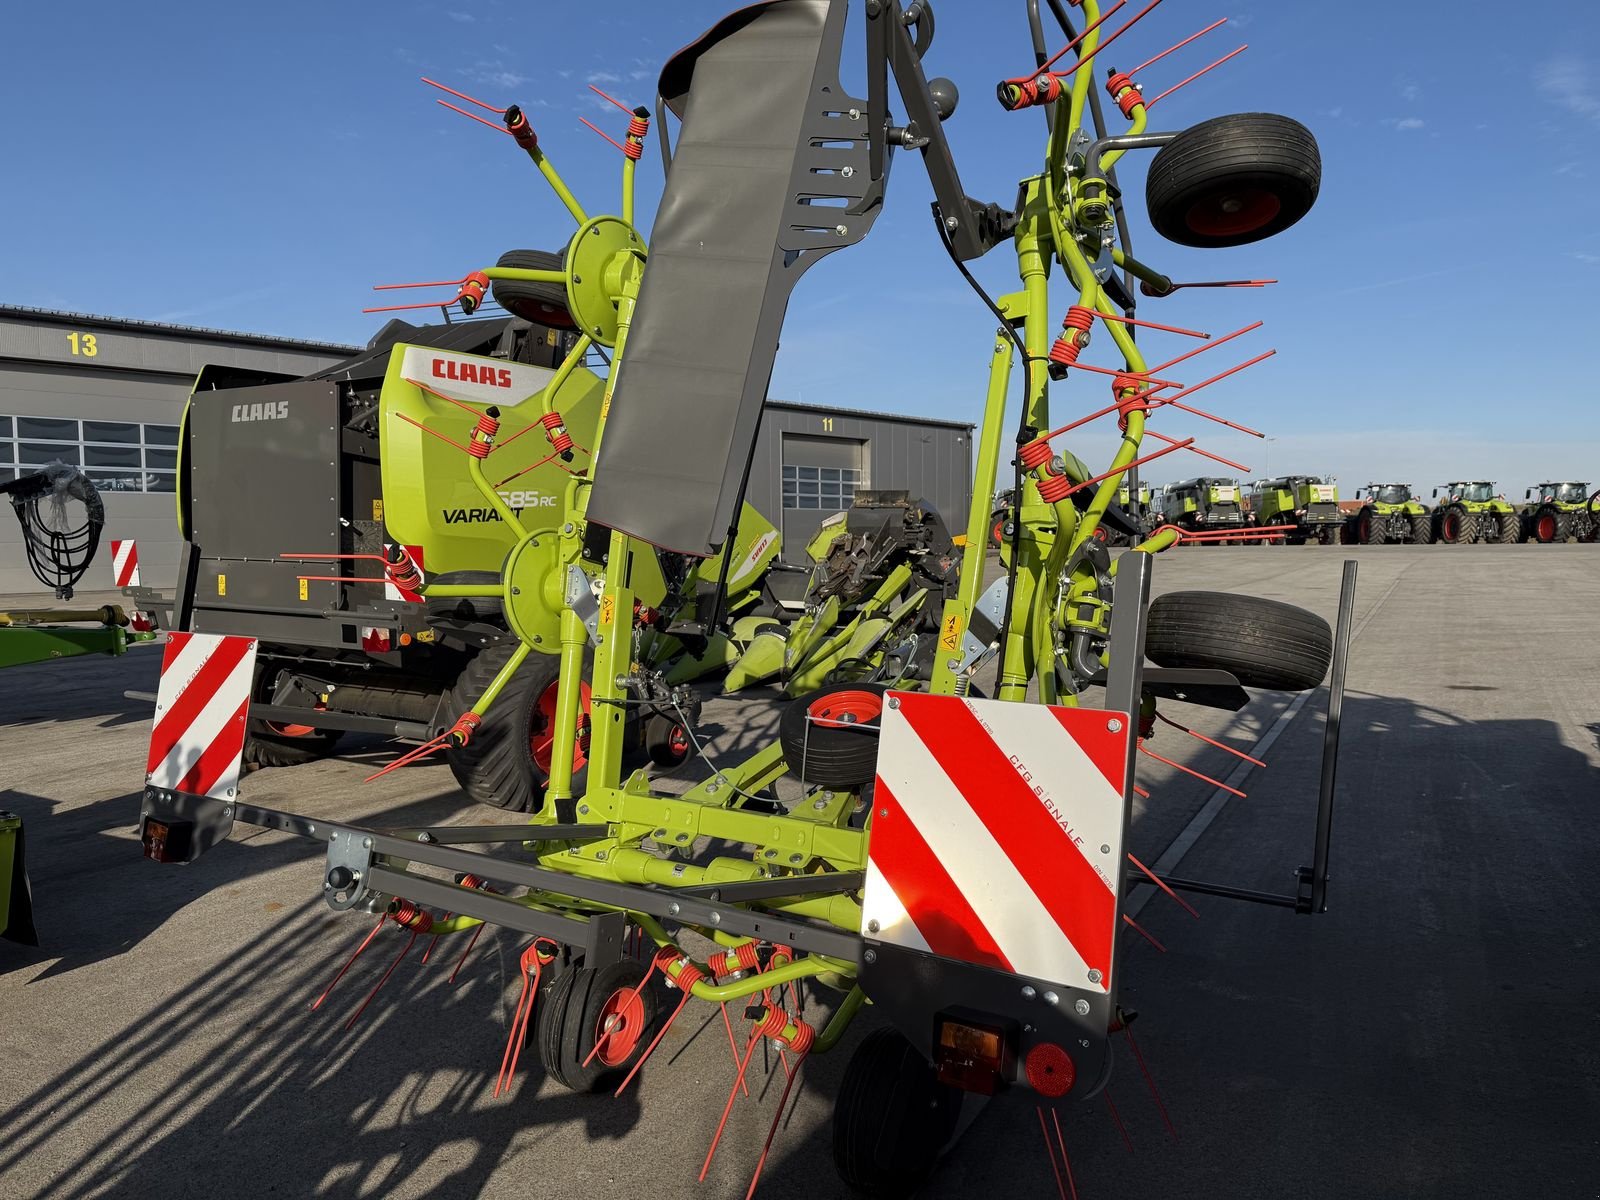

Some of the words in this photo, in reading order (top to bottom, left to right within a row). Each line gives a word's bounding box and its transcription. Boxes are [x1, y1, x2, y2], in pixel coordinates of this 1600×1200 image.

[66, 332, 97, 357] 13
[432, 358, 512, 388] CLAAS
[231, 400, 289, 423] CLAAS
[822, 417, 833, 432] 11
[540, 495, 557, 507] RC
[1009, 754, 1033, 783] CFG
